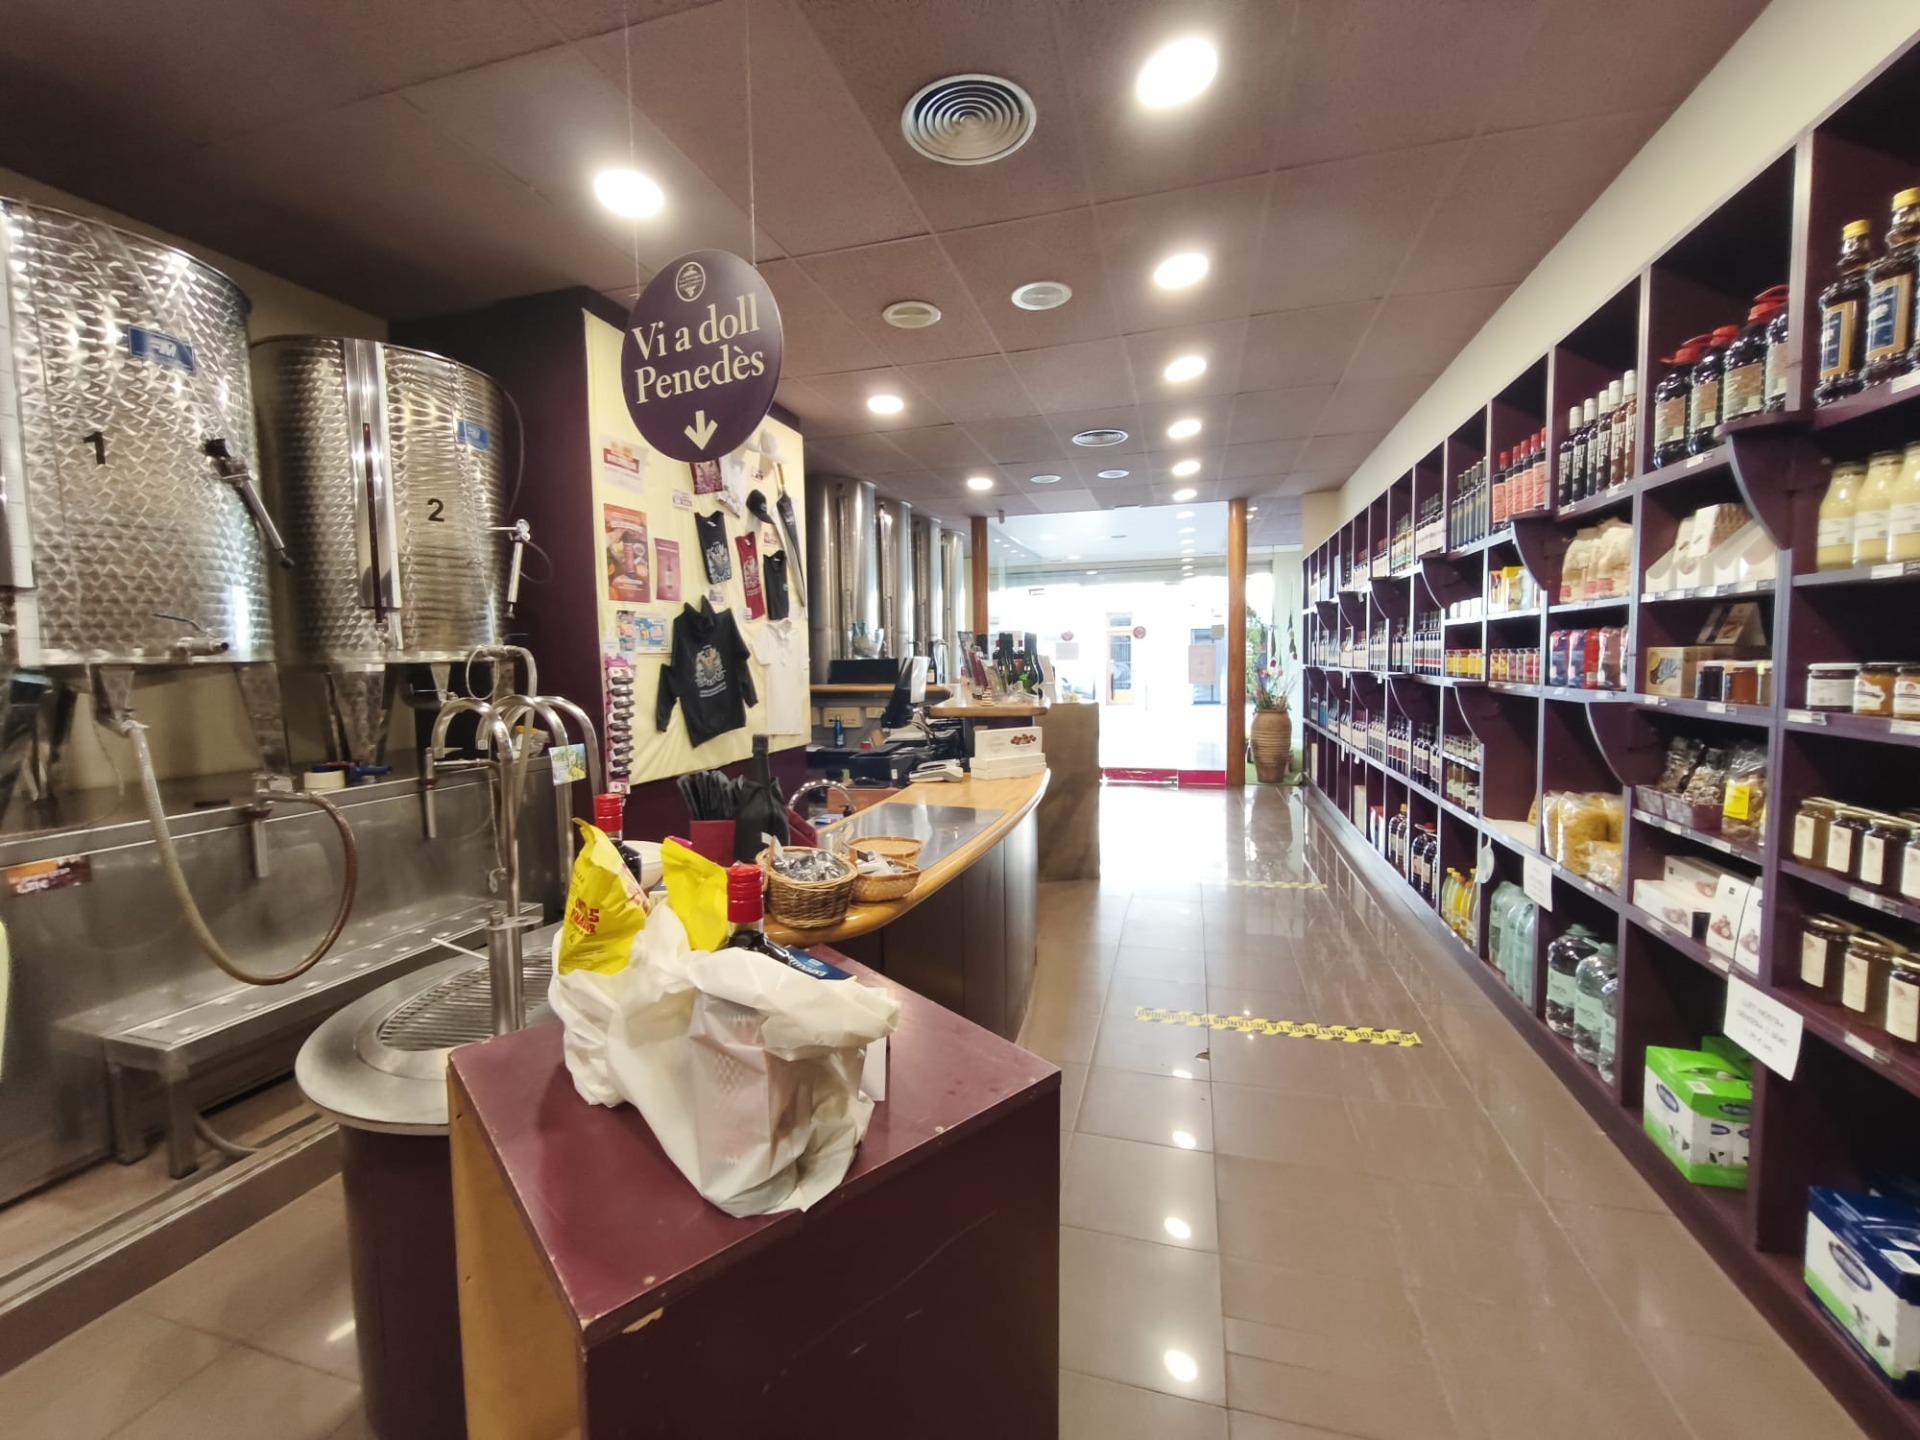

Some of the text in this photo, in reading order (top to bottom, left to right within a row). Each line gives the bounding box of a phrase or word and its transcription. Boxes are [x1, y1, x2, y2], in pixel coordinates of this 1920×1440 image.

[631, 294, 760, 361] Vi a doll
[635, 345, 764, 404] Penedès
[83, 431, 106, 465] 1
[427, 498, 445, 522] 2
